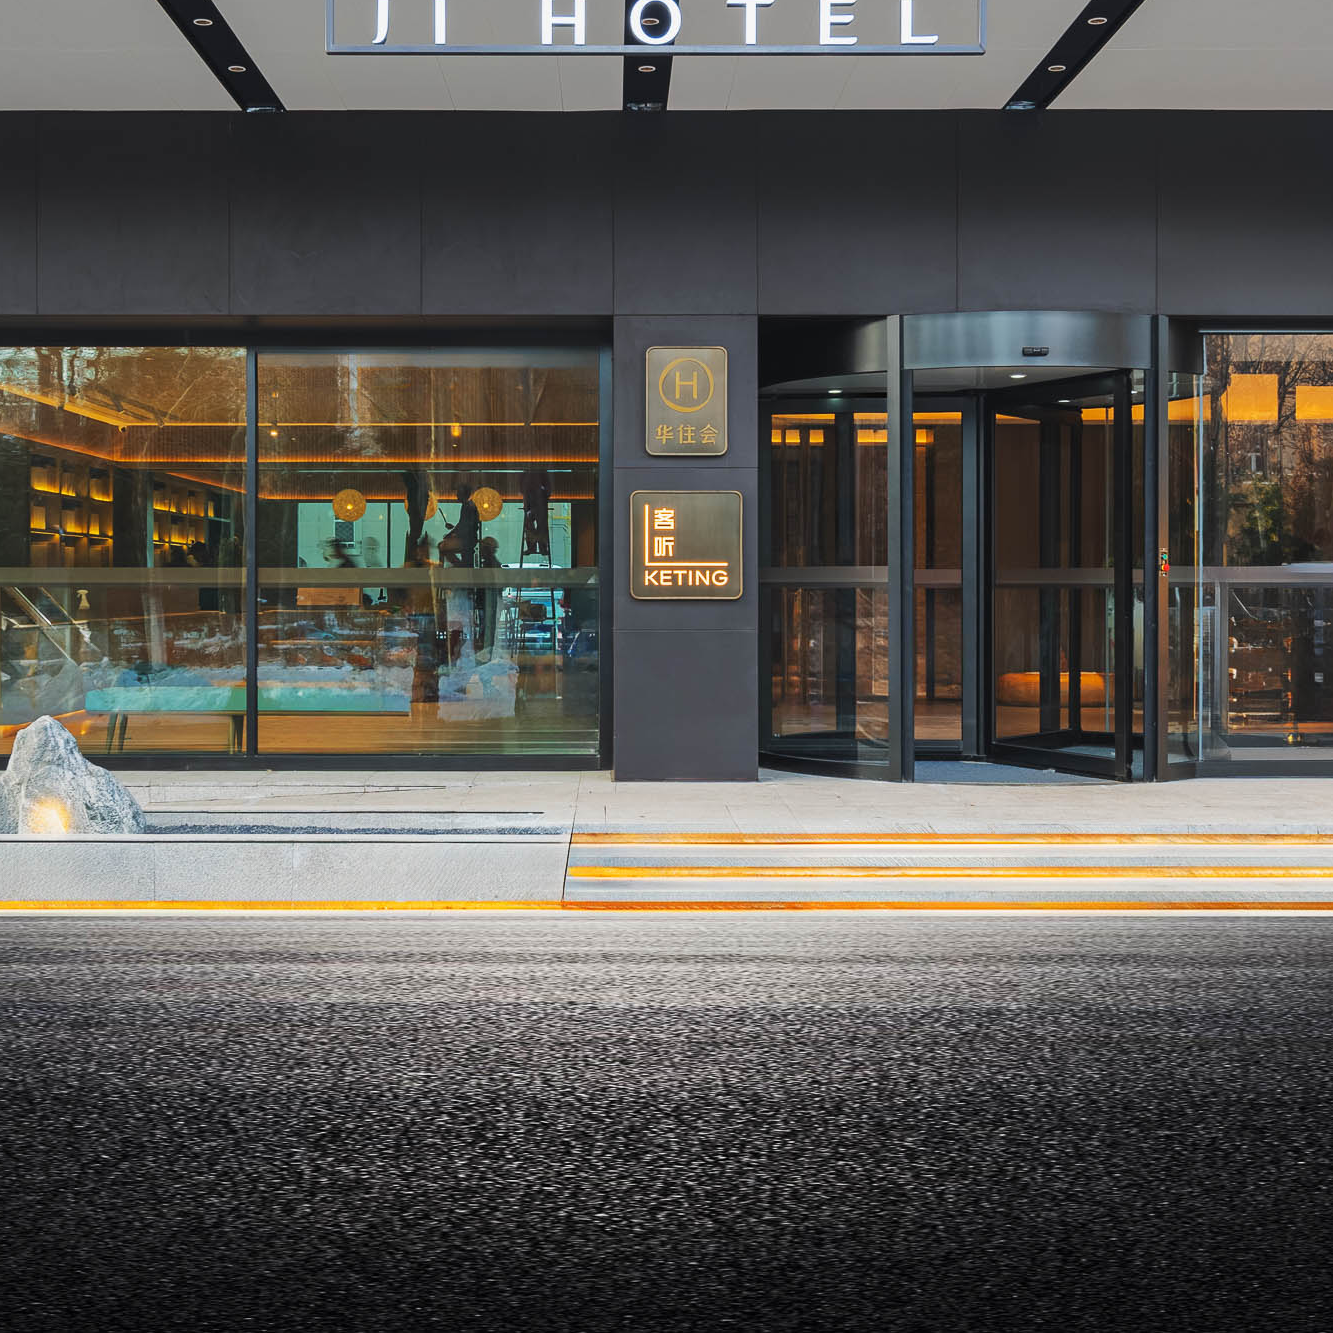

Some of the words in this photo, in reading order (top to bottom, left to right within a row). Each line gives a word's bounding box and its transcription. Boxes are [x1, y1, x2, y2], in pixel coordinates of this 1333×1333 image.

[655, 423, 718, 445] 华住会
[654, 507, 675, 557] 客听
[644, 569, 729, 587] KETING
